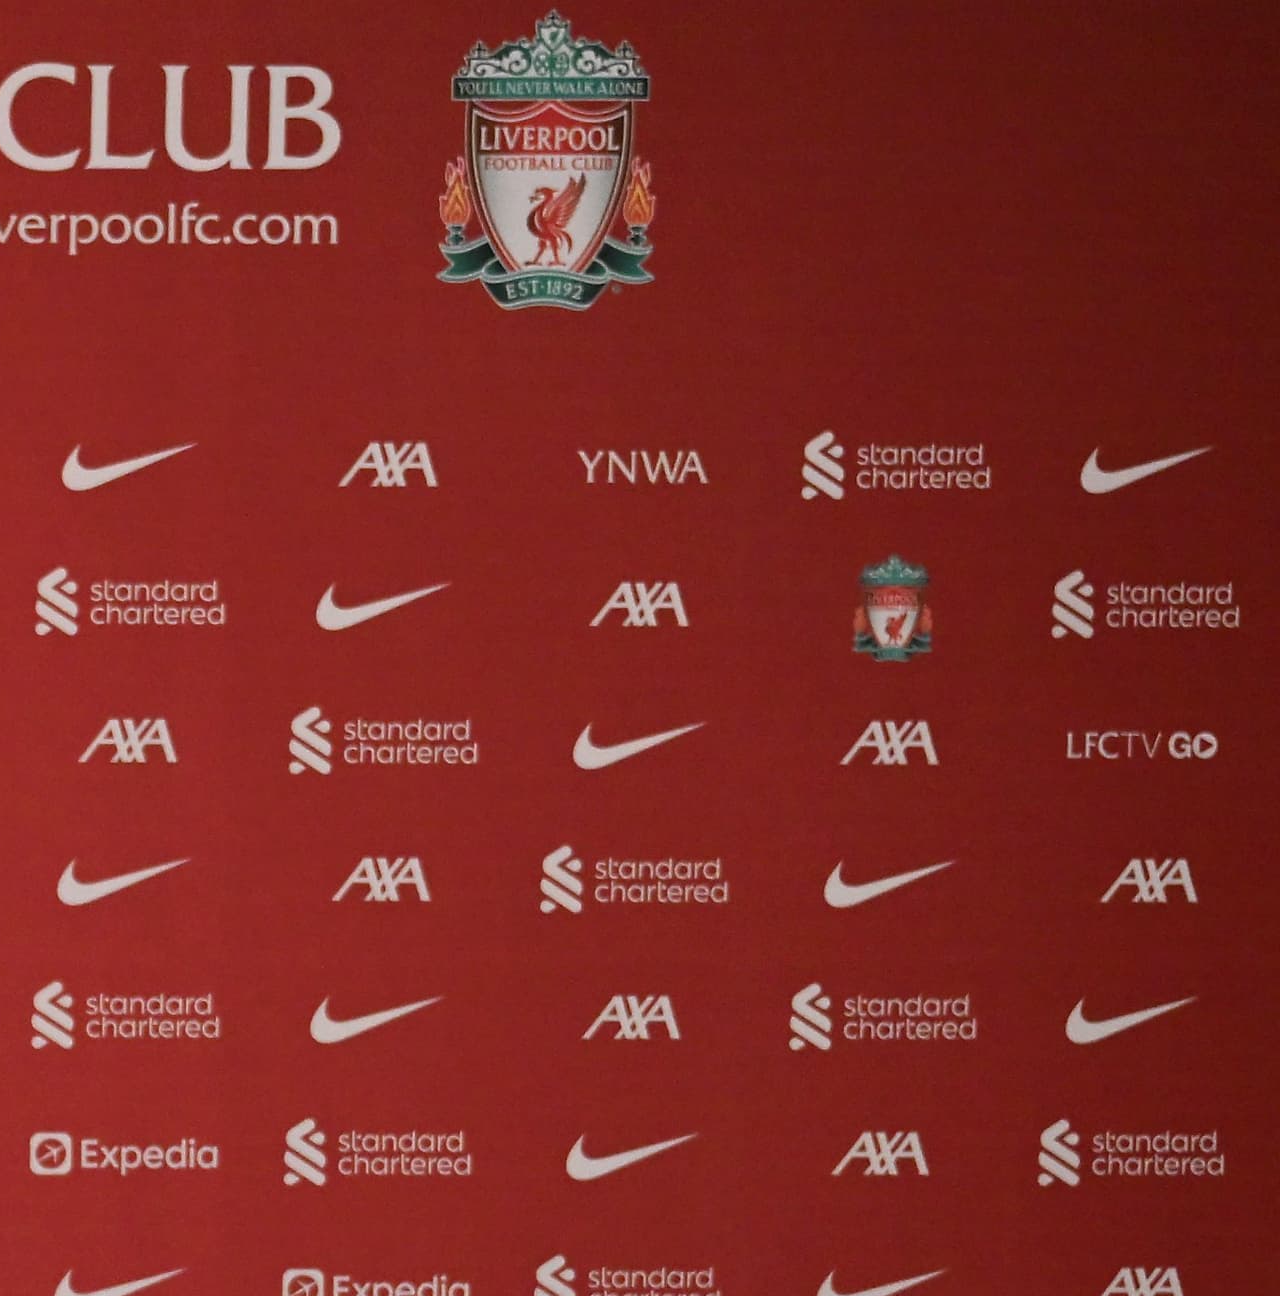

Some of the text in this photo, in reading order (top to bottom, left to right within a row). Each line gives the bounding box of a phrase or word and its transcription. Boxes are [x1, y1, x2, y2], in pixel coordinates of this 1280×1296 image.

[506, 82, 551, 96] NEVER
[552, 82, 595, 96] WALK
[597, 82, 644, 96] ALONE
[480, 125, 619, 151] LIVERPOOL
[485, 157, 613, 171] FOOTBALL CLUB
[339, 441, 438, 487] AXA
[578, 450, 708, 484] YNWA
[590, 582, 689, 627] AXA
[1107, 582, 1232, 604] standard
[1106, 606, 1240, 628] chartered
[78, 718, 178, 763] AXA
[344, 719, 471, 741] standard
[344, 742, 478, 764] chartered
[840, 720, 939, 765] AXA
[332, 857, 431, 902] AXA
[595, 858, 721, 880] standard
[1100, 858, 1198, 903] AXA
[595, 881, 728, 903] chartered
[86, 994, 212, 1016] standard
[844, 995, 970, 1018] standard
[86, 1016, 220, 1038] chartered
[582, 995, 681, 1040] AXA
[844, 1018, 977, 1040] chartered
[832, 1131, 929, 1176] AXA
[1093, 1131, 1217, 1154] standard
[81, 1138, 219, 1176] Expedia
[1092, 1154, 1224, 1175] chartered
